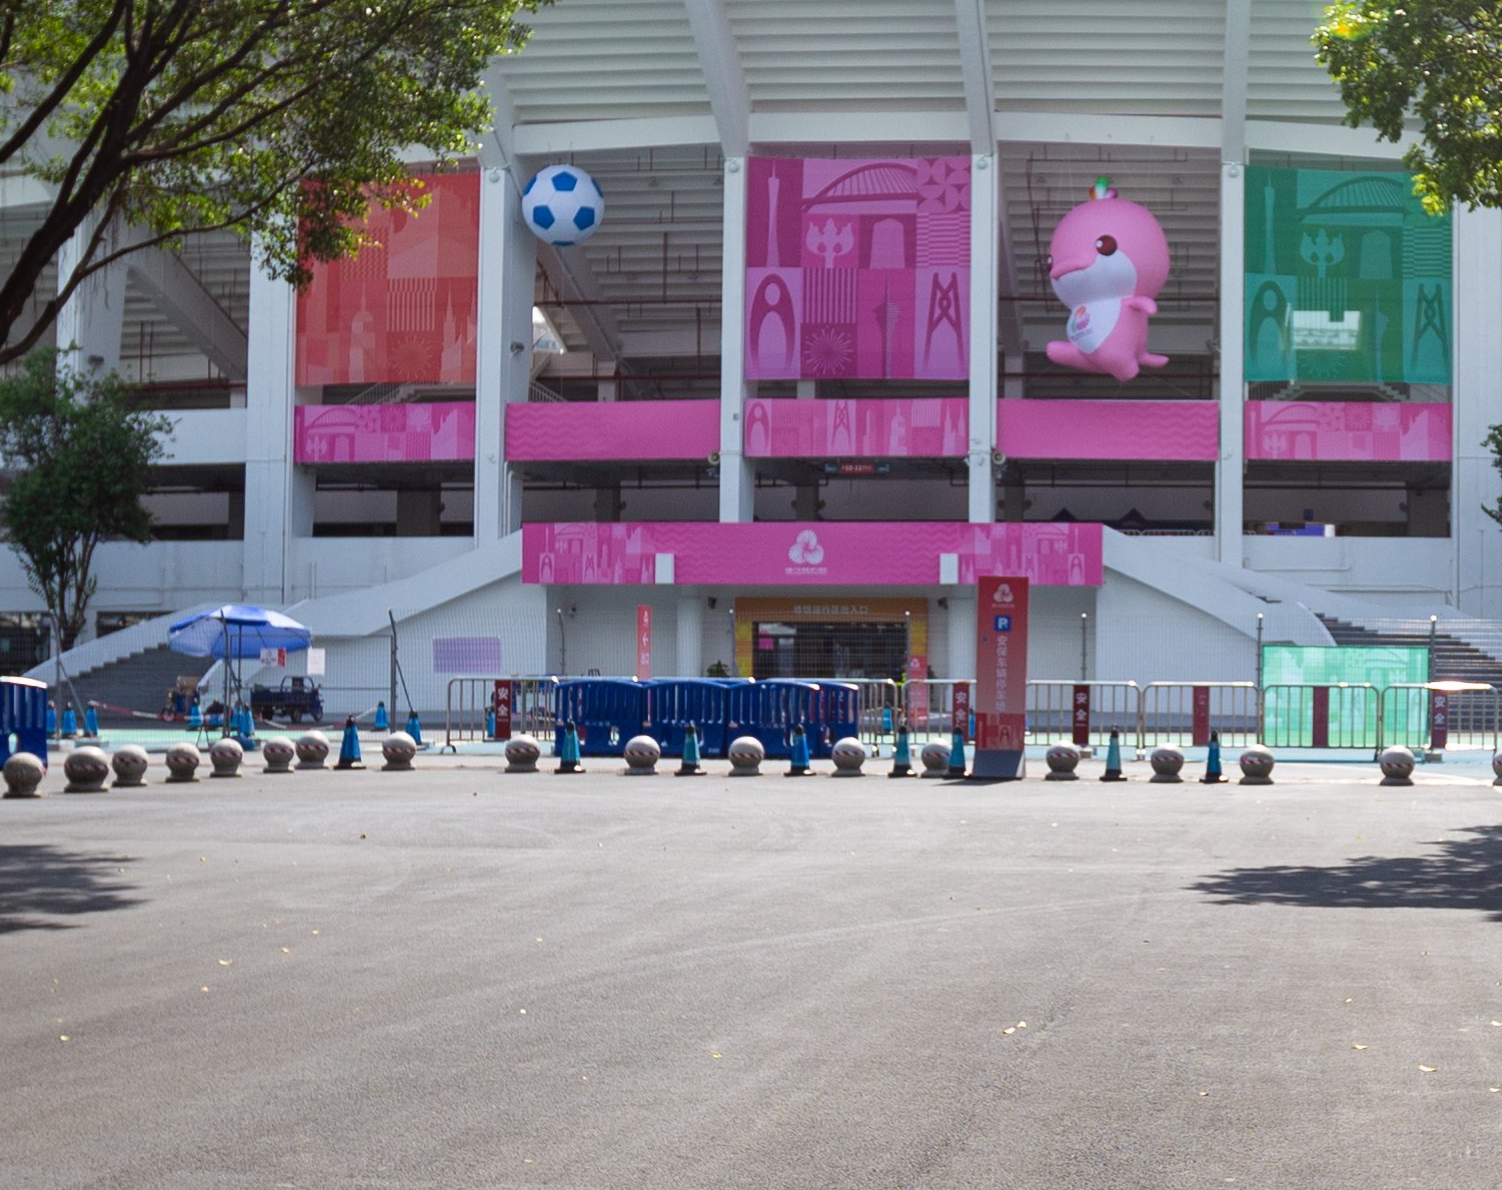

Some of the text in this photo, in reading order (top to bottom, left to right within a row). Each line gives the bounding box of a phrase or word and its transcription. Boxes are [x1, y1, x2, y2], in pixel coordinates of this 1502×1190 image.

[995, 634, 1008, 713] 安保车辆停车场
[497, 686, 509, 717] 安全
[954, 690, 967, 721] 安全
[1075, 692, 1087, 721] 安全
[1434, 695, 1446, 724] 安全
